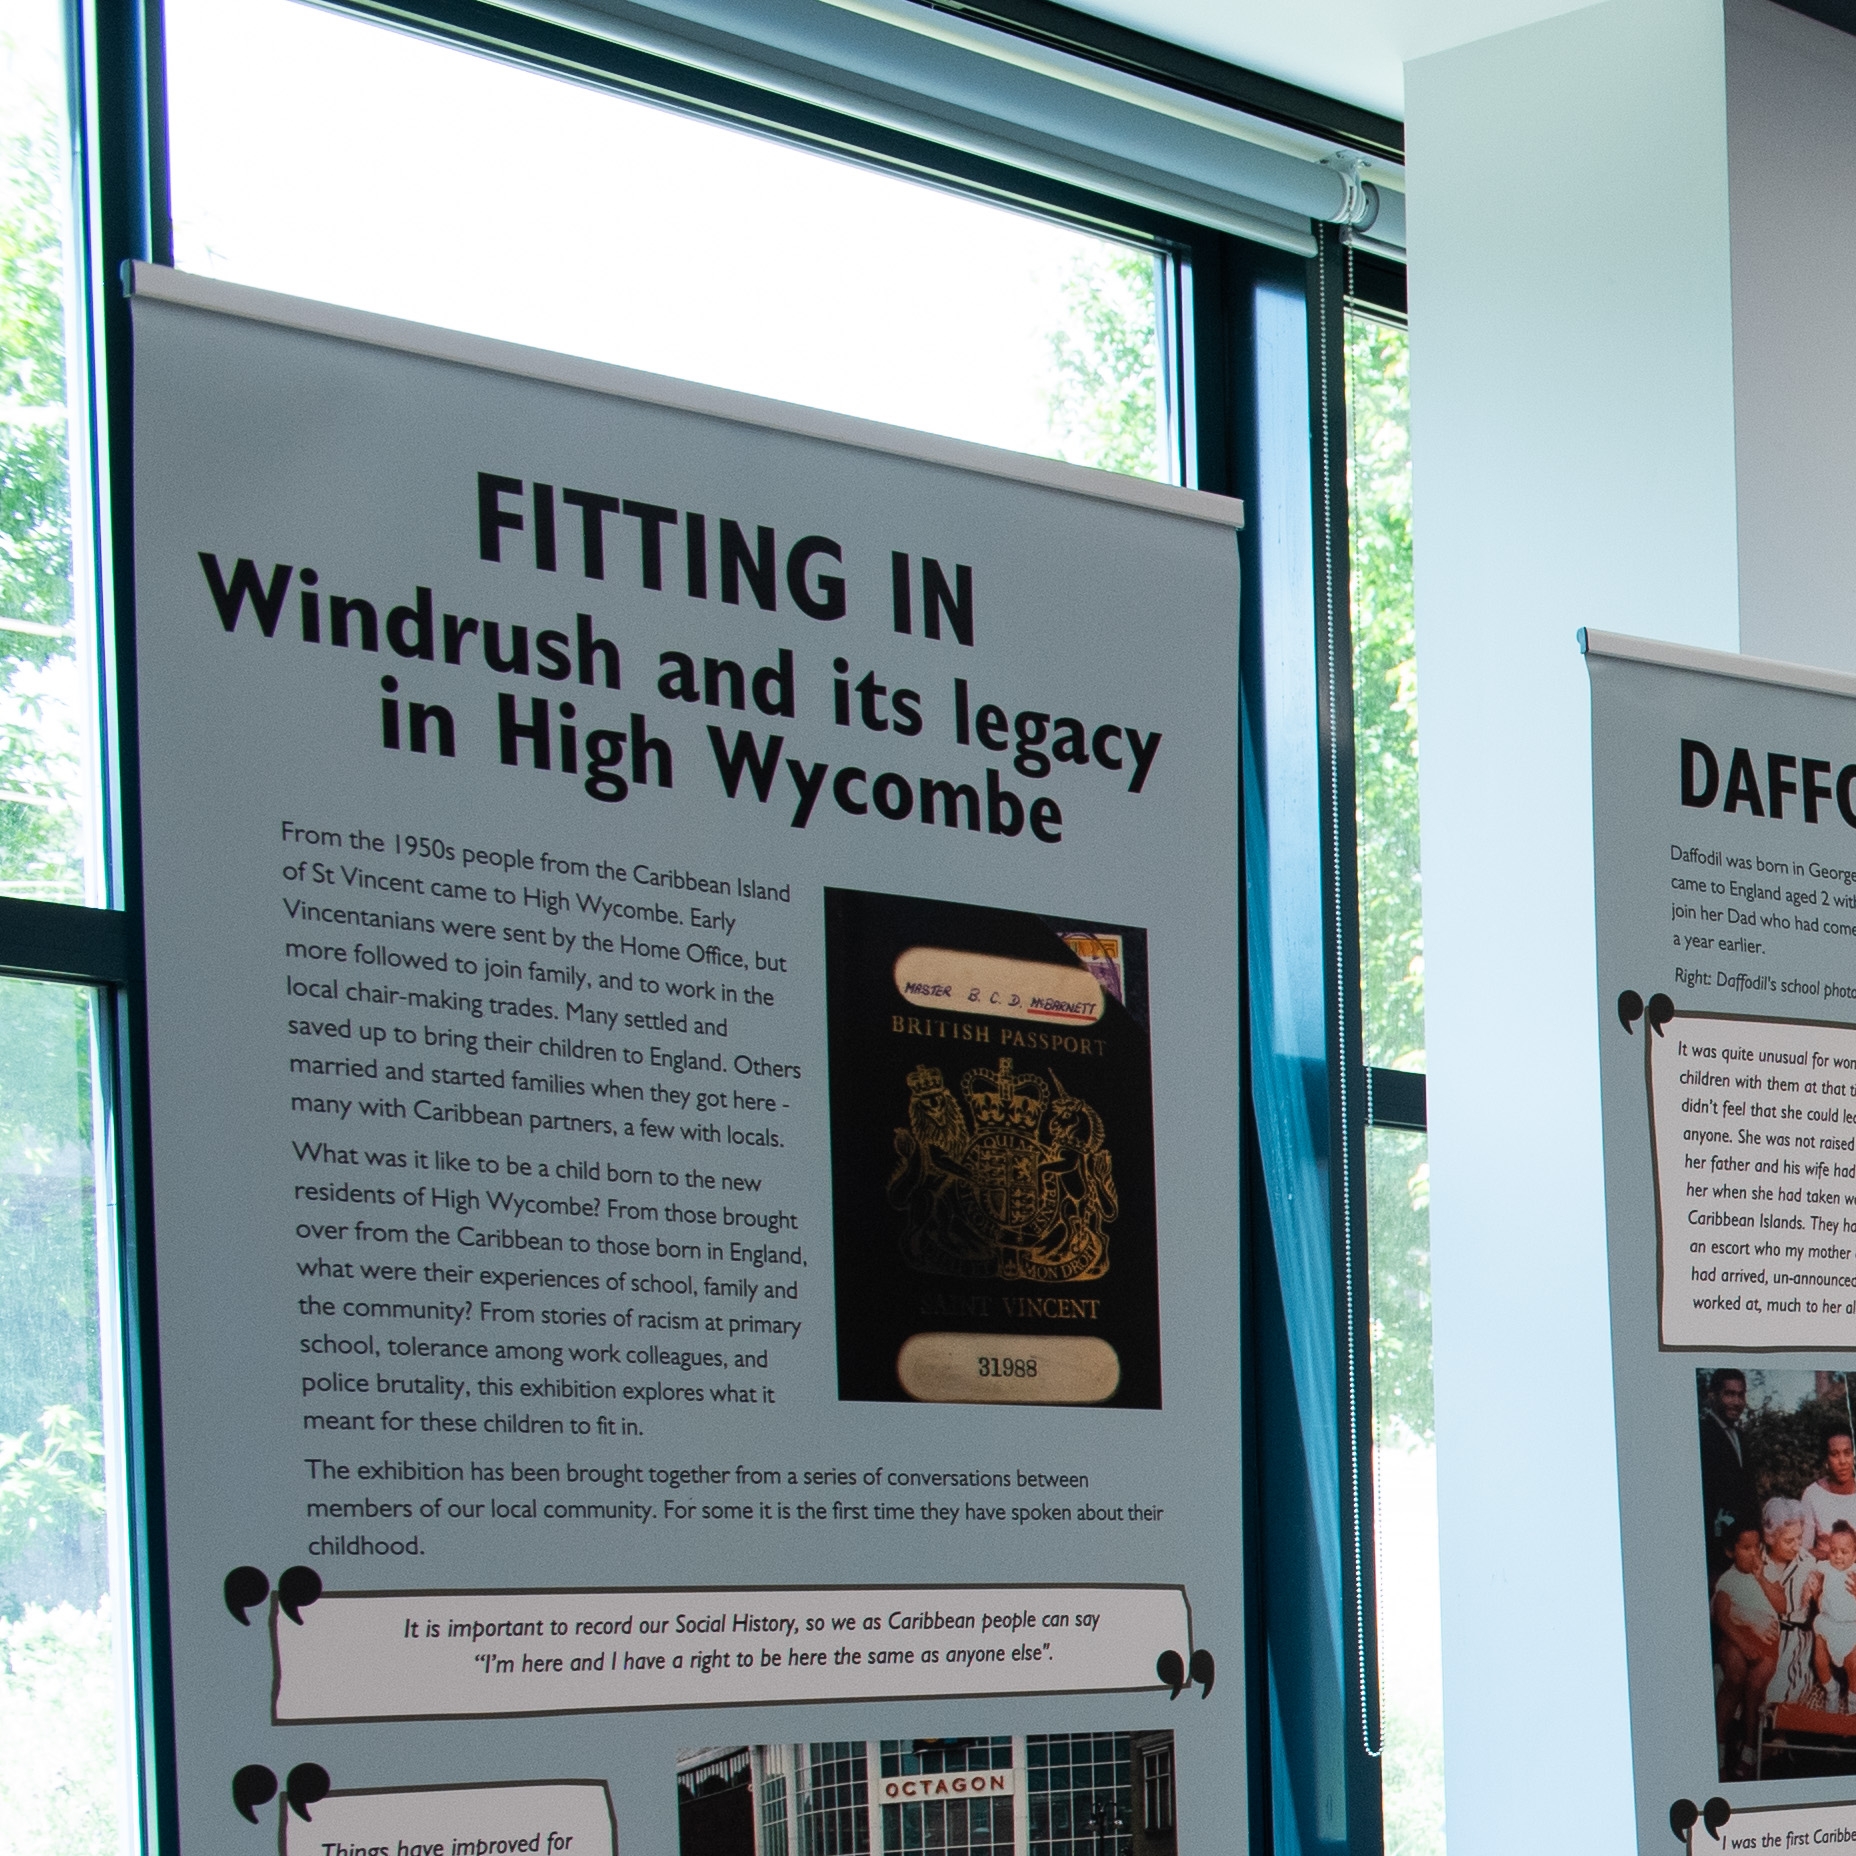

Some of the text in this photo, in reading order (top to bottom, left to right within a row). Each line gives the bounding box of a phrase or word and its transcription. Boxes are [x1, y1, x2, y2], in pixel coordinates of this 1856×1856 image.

[477, 471, 974, 647] FITTING IN
[198, 551, 1163, 794] Windrush and its legacy
[380, 674, 1062, 844] in High Wycombe
[281, 820, 790, 903] From the 1950s people from the Caribbean Island
[1670, 844, 1722, 866] Daffodil
[1725, 856, 1753, 870] was
[1755, 855, 1789, 875] born
[1792, 864, 1805, 877] in
[904, 982, 952, 999] MASTER
[892, 1016, 1107, 1057] BRITISH PASSPORT
[1023, 1245, 1097, 1281] MON DROIT
[1005, 1297, 1101, 1320] VINCENT
[977, 1355, 1038, 1379] 31988
[885, 1775, 1005, 1799] OCTAGON
